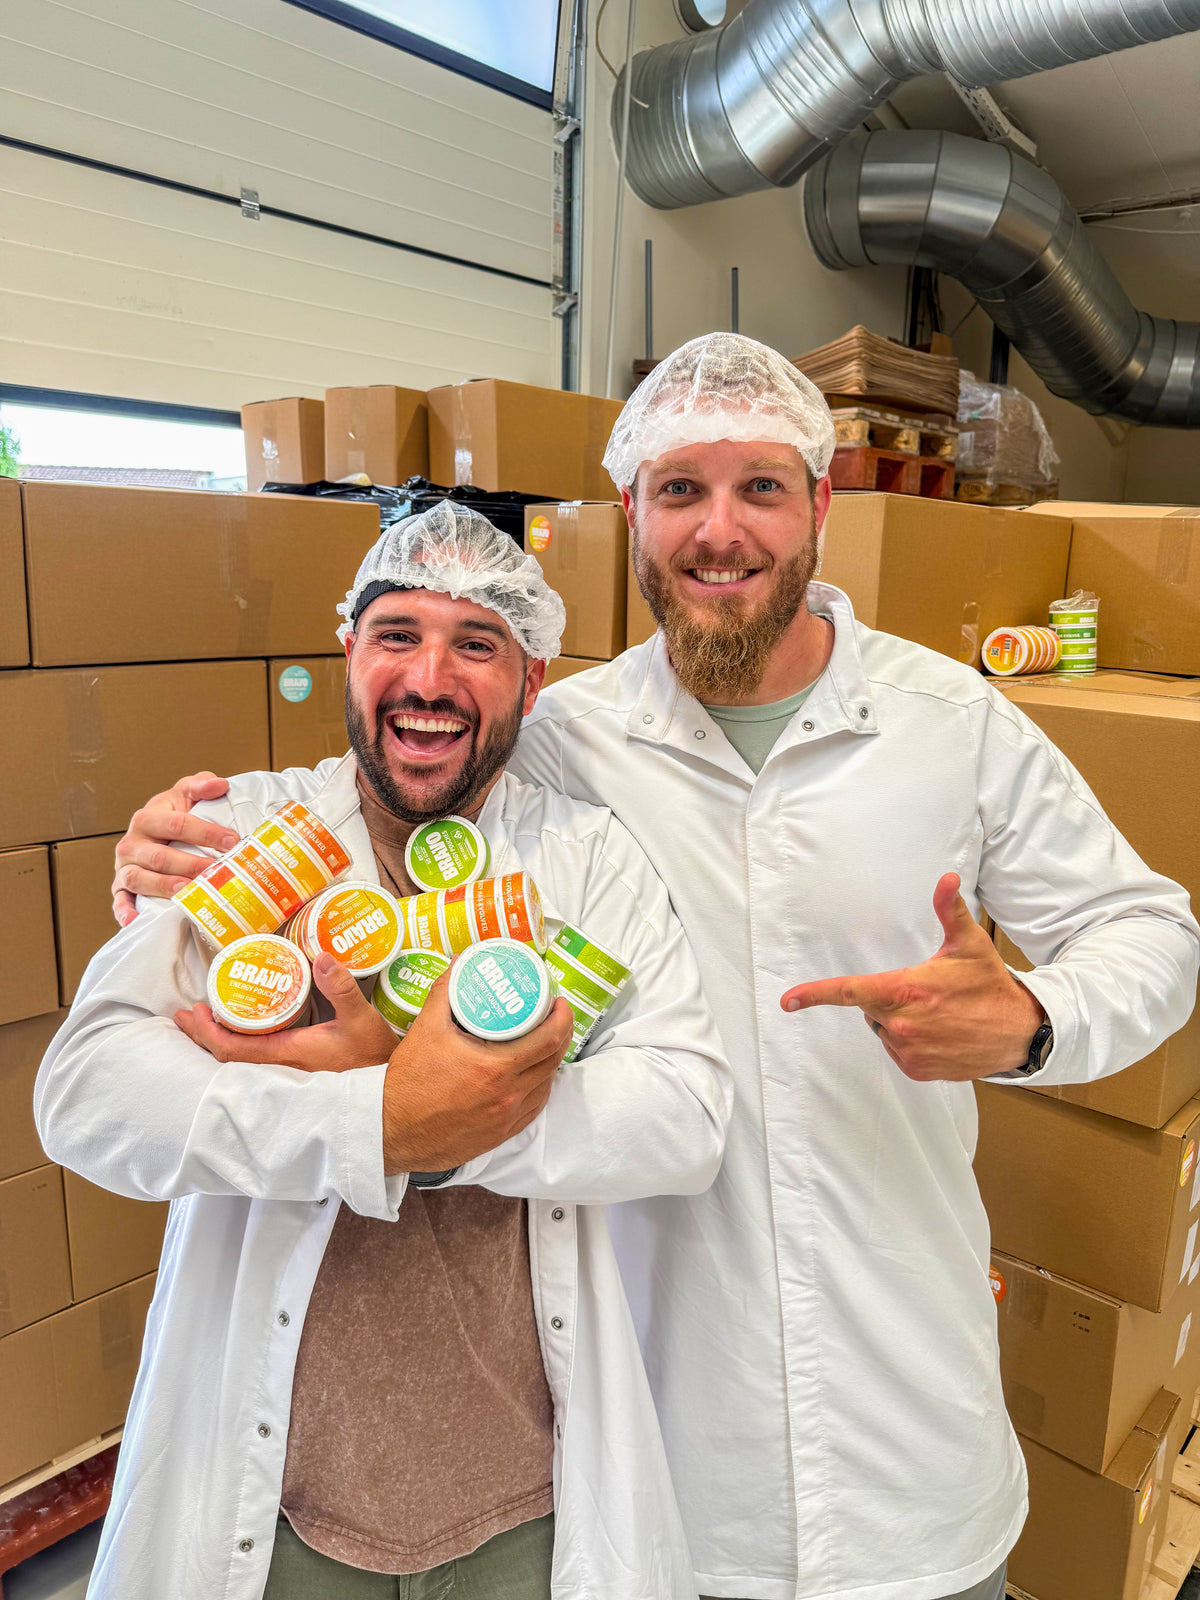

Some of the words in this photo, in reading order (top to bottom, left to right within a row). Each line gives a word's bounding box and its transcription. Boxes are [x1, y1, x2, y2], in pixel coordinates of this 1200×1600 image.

[269, 840, 298, 868] BRAVO
[442, 830, 454, 852] POUCHES
[426, 832, 458, 880] BRAVO
[452, 852, 463, 869] ENERGY
[245, 860, 257, 871] HAS
[255, 870, 278, 894] EVOLVED.
[196, 907, 226, 936] BRAVO
[355, 904, 374, 918] ENERGY
[478, 903, 487, 931] EVOLVED.
[329, 917, 354, 935] POUCHES
[332, 908, 388, 953] BRAVO
[418, 915, 431, 947] BRAVO
[228, 960, 292, 995] BRAVO
[398, 967, 434, 990] AVO
[408, 962, 432, 976] POUCHES
[230, 980, 253, 990] ENERGY
[472, 972, 488, 993] ENERGY
[486, 992, 505, 1017] POUCHES
[476, 956, 524, 1014] BRAVO
